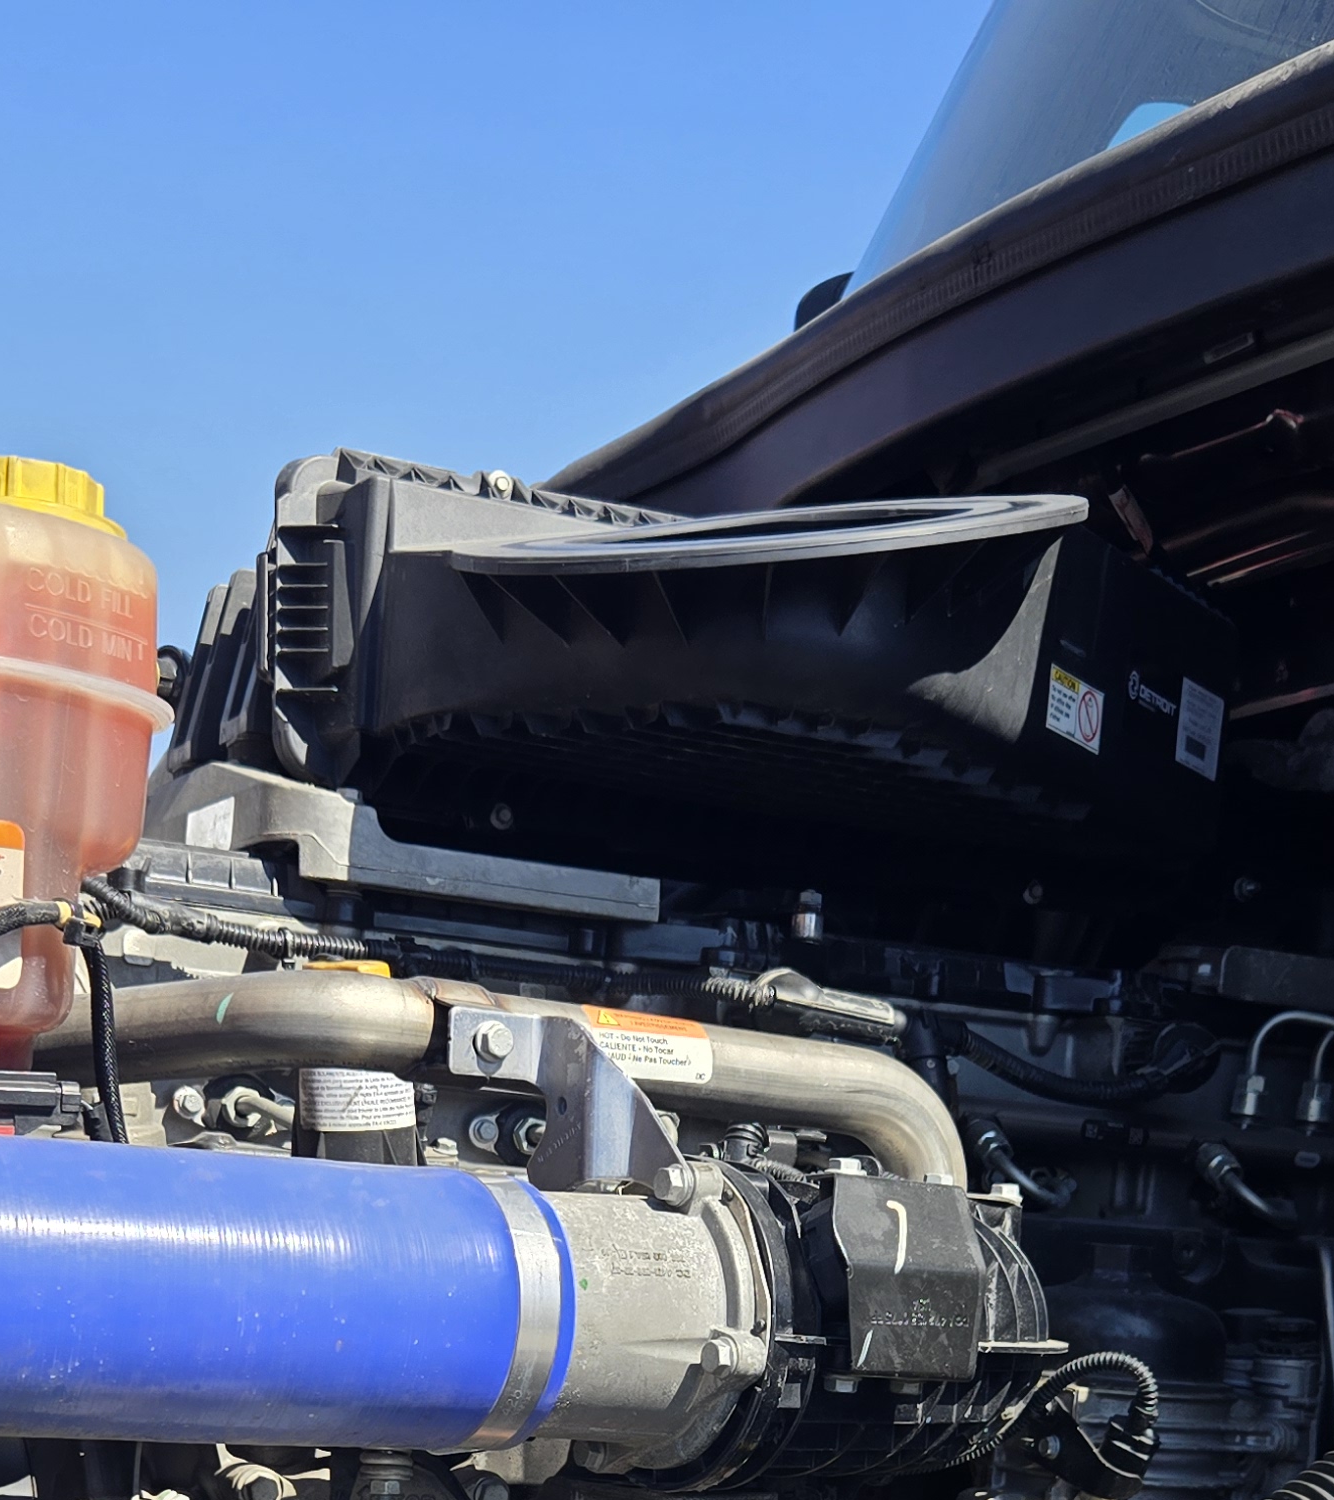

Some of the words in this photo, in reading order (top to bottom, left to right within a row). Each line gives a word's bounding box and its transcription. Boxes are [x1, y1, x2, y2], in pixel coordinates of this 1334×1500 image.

[27, 567, 91, 603] COLD
[101, 588, 133, 619] FILL
[29, 613, 93, 648] COLD
[599, 1041, 636, 1052] CALIENTE
[655, 1046, 674, 1055] Tocar
[633, 1035, 645, 1043] Not
